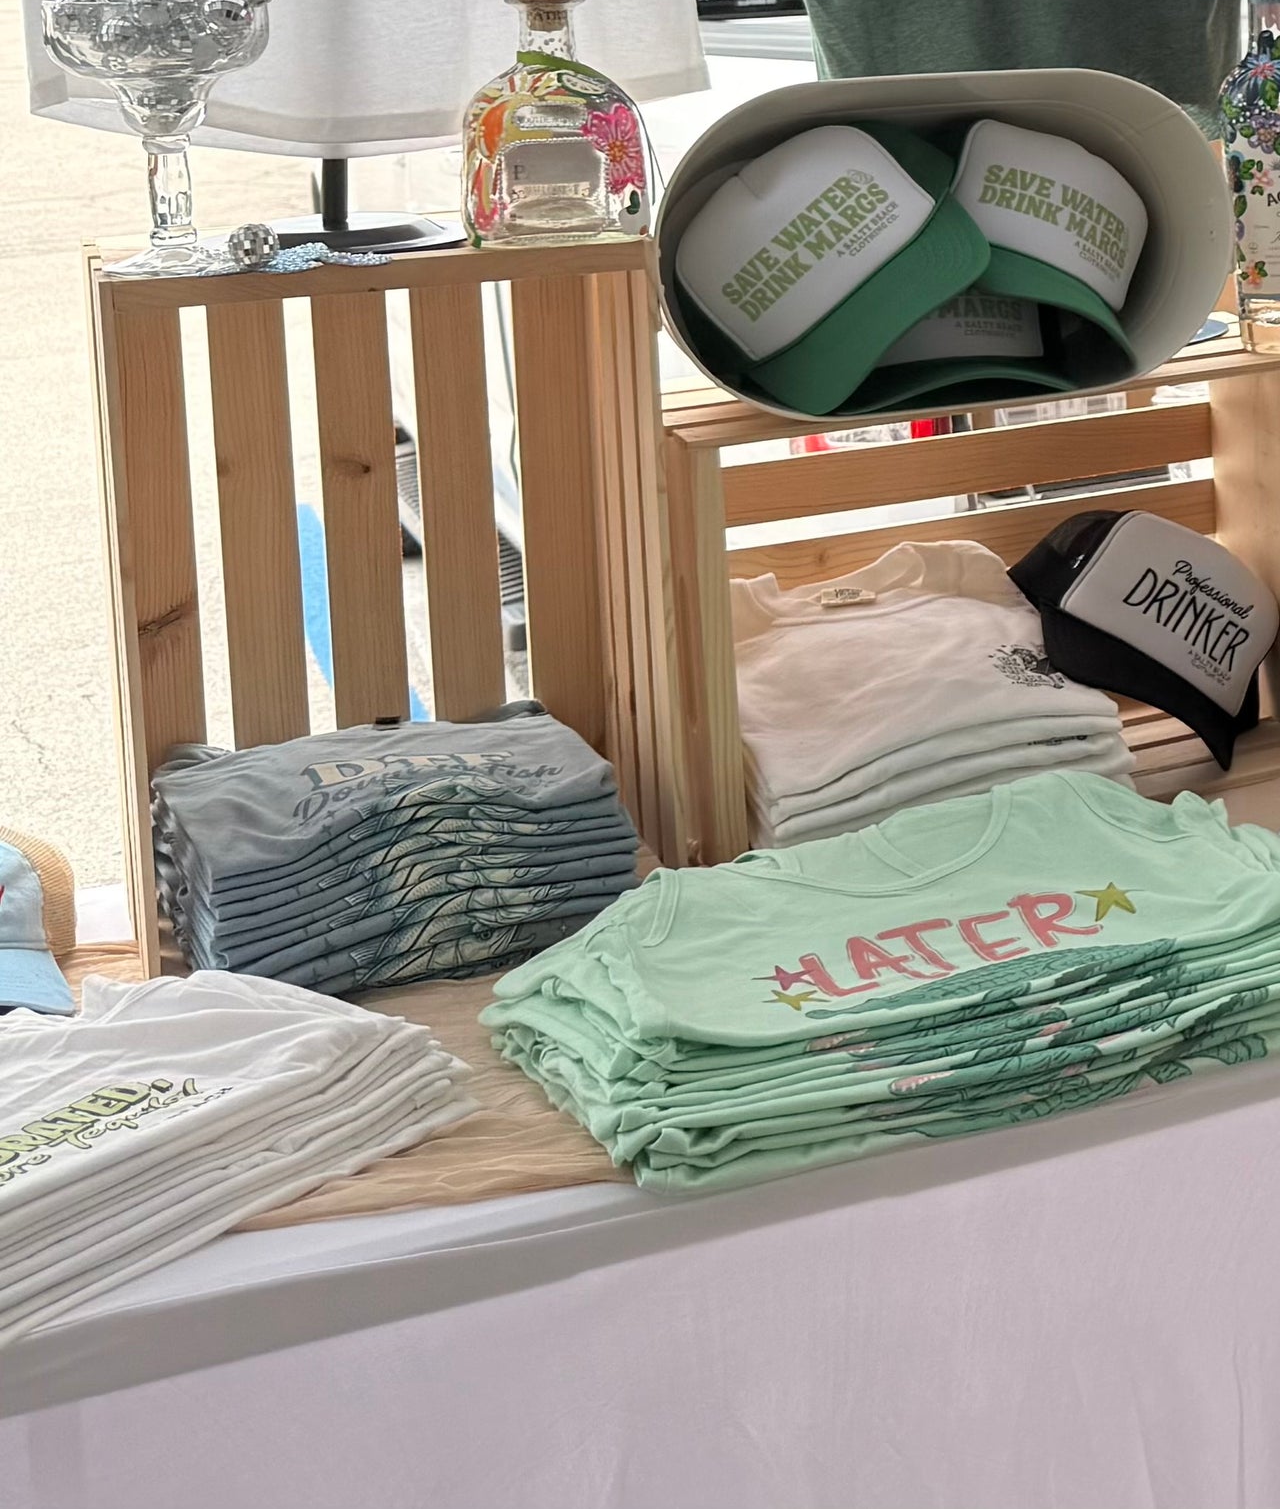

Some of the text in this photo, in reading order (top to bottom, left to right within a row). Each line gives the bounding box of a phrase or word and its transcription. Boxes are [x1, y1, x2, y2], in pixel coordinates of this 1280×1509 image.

[721, 175, 863, 306] SAVE WATER
[836, 201, 899, 258] A SALTY BEACH
[848, 221, 888, 258] CLOTHING
[977, 183, 1128, 271] DRINK MARGS
[983, 164, 1126, 242] SAVE WATER
[738, 182, 890, 323] DRINK MARGS
[938, 298, 1023, 321] MARGS
[1122, 567, 1250, 673] DRINKER
[1171, 559, 1255, 620] Professional
[300, 751, 515, 790] DTF
[798, 891, 1104, 998] LATER
